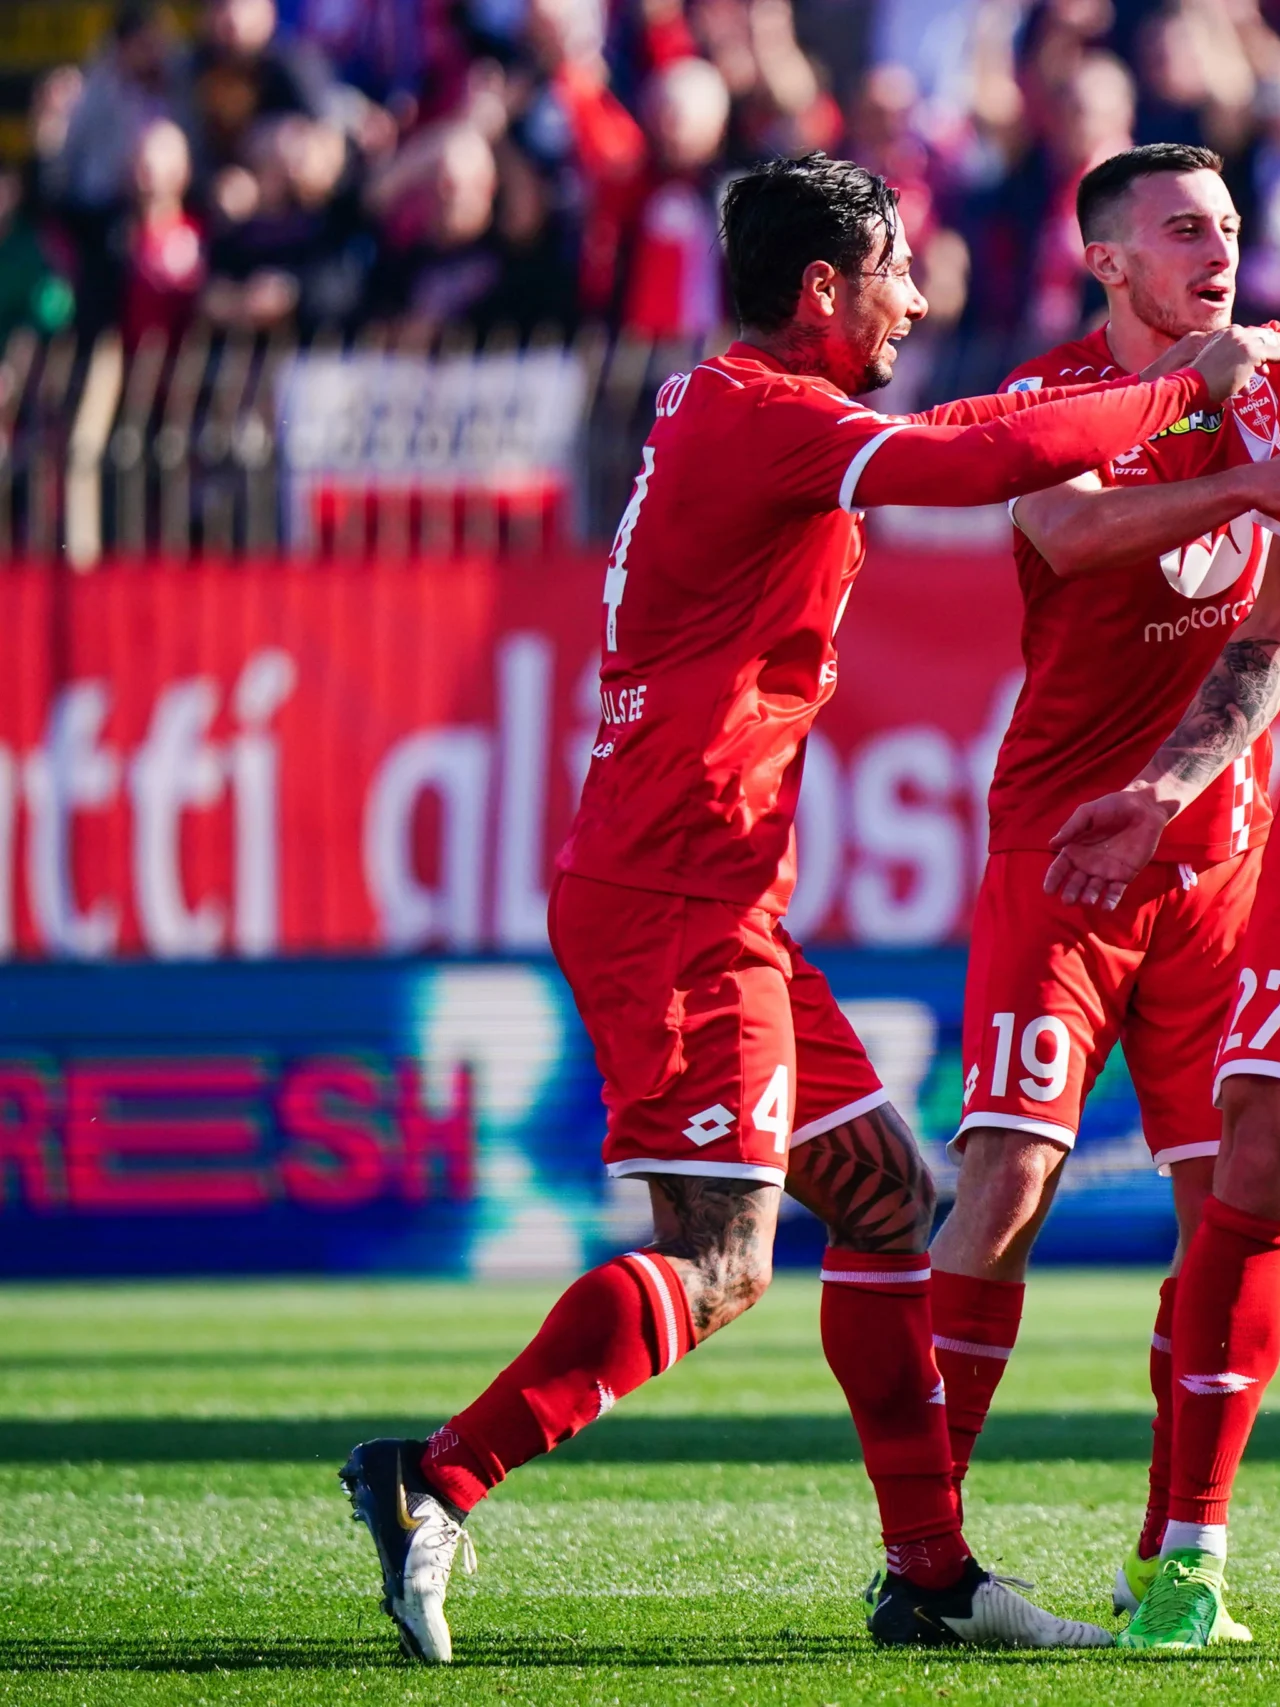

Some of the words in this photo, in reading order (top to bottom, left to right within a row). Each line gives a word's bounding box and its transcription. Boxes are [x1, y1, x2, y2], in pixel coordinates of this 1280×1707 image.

[1239, 396, 1270, 416] MONZA
[1114, 467, 1148, 475] OTTO
[600, 685, 647, 724] ULSEE
[991, 1012, 1071, 1102] 19
[752, 1064, 779, 1154] 4
